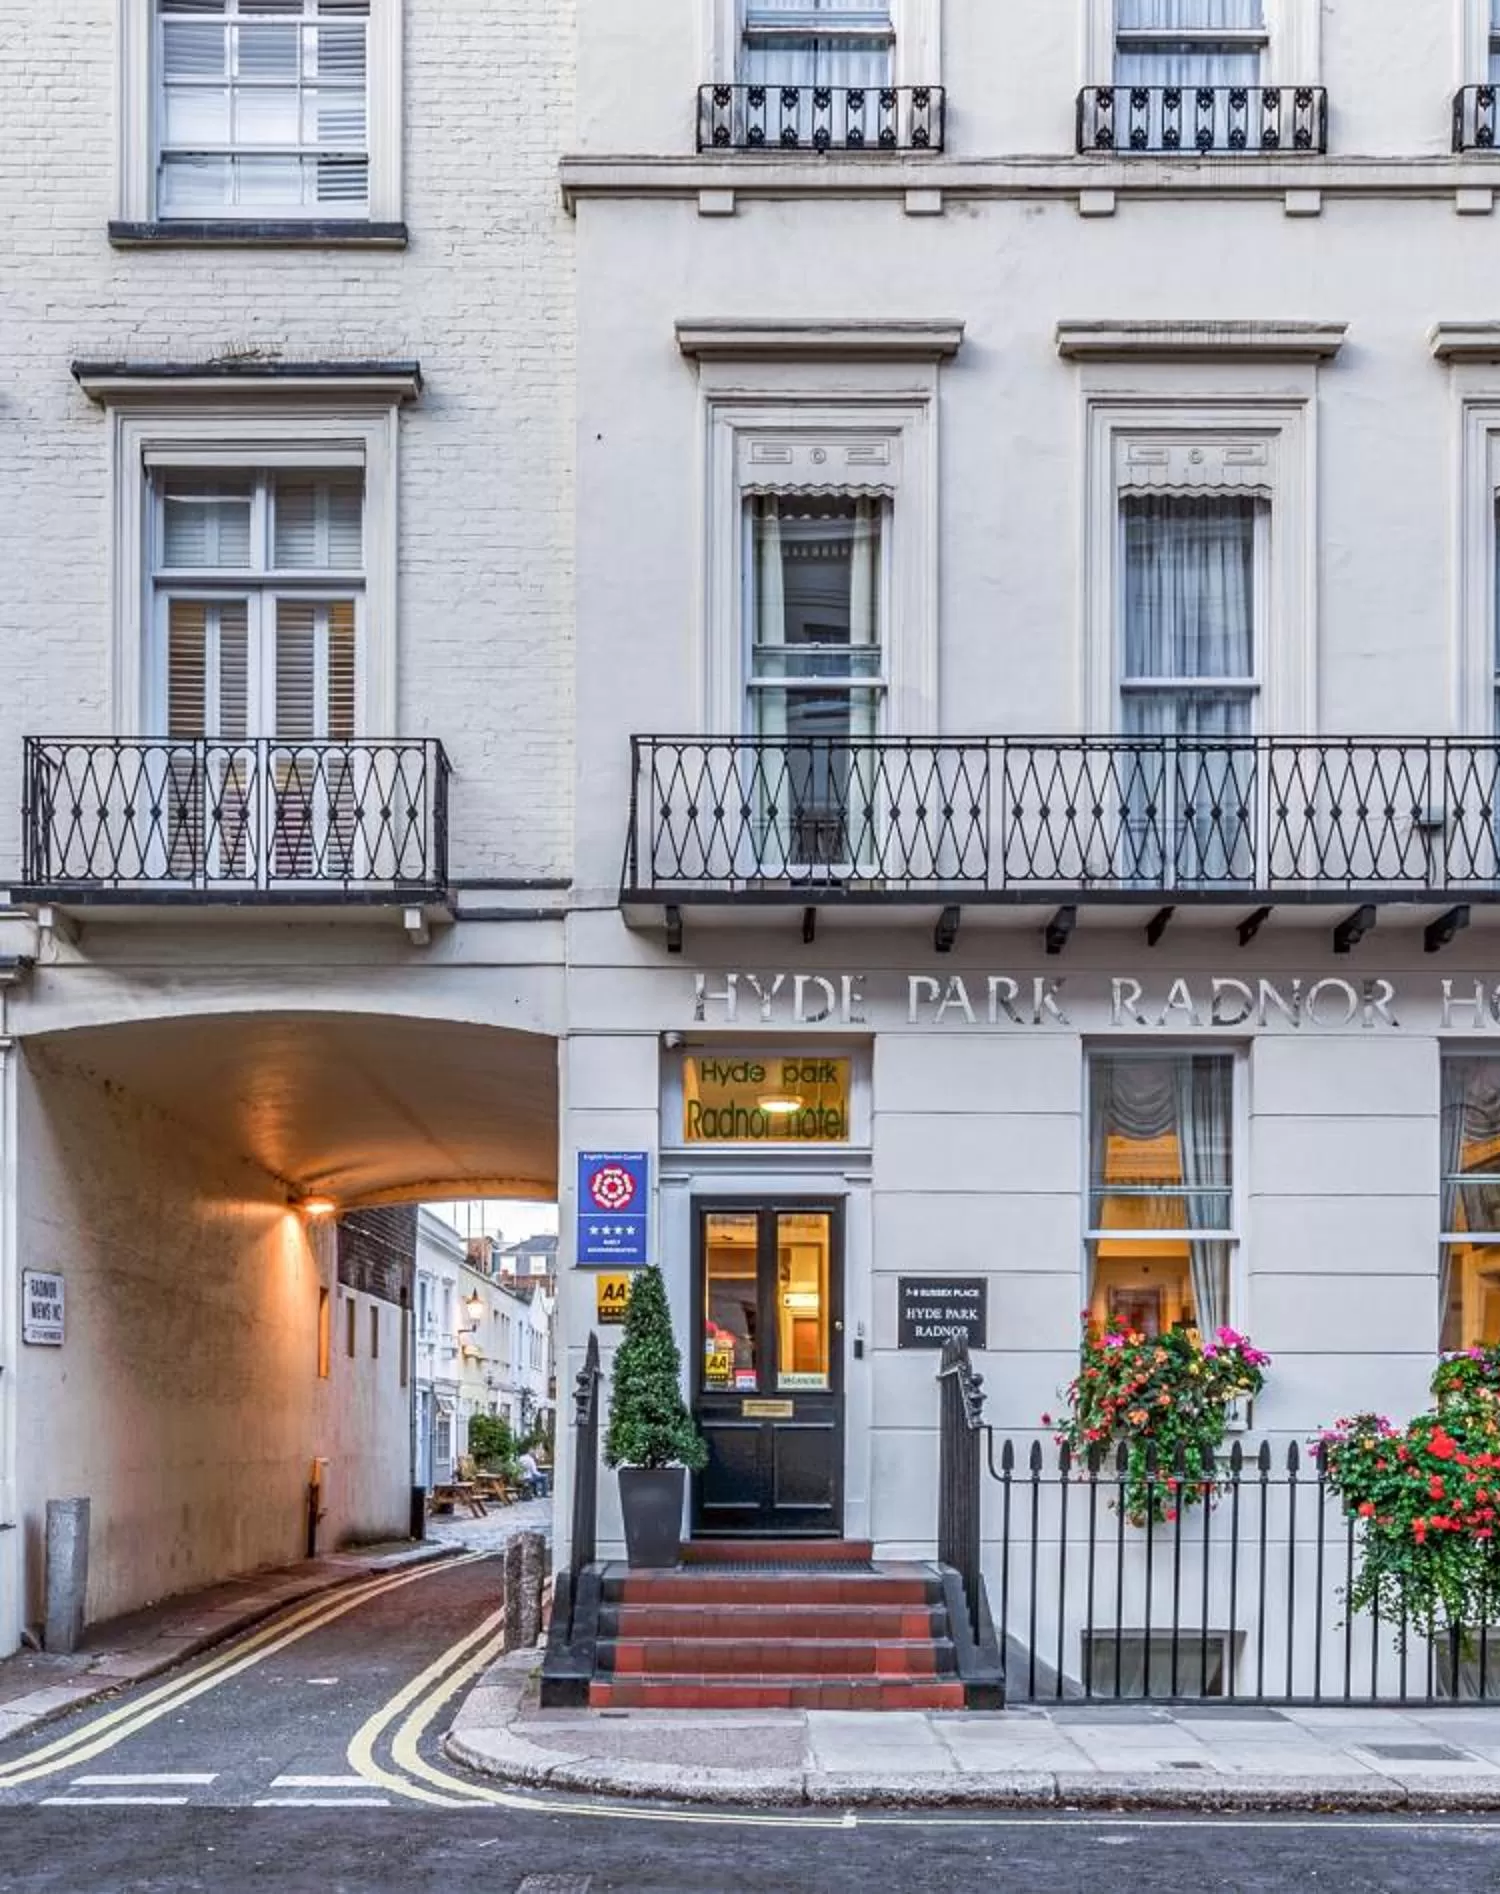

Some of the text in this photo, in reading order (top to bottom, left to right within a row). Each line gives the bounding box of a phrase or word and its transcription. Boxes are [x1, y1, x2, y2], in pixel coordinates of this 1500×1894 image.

[693, 973, 867, 1023] HYDE
[907, 974, 1072, 1025] PARK
[1108, 976, 1401, 1029] RADNOR
[701, 1060, 838, 1087] Hyde park
[31, 1279, 57, 1298] RADNOR
[602, 1282, 626, 1301] AA
[953, 1289, 979, 1297] PLACE
[906, 1307, 979, 1321] HYDE PARK
[915, 1325, 969, 1338] RADNOR
[709, 1355, 727, 1369] AA
